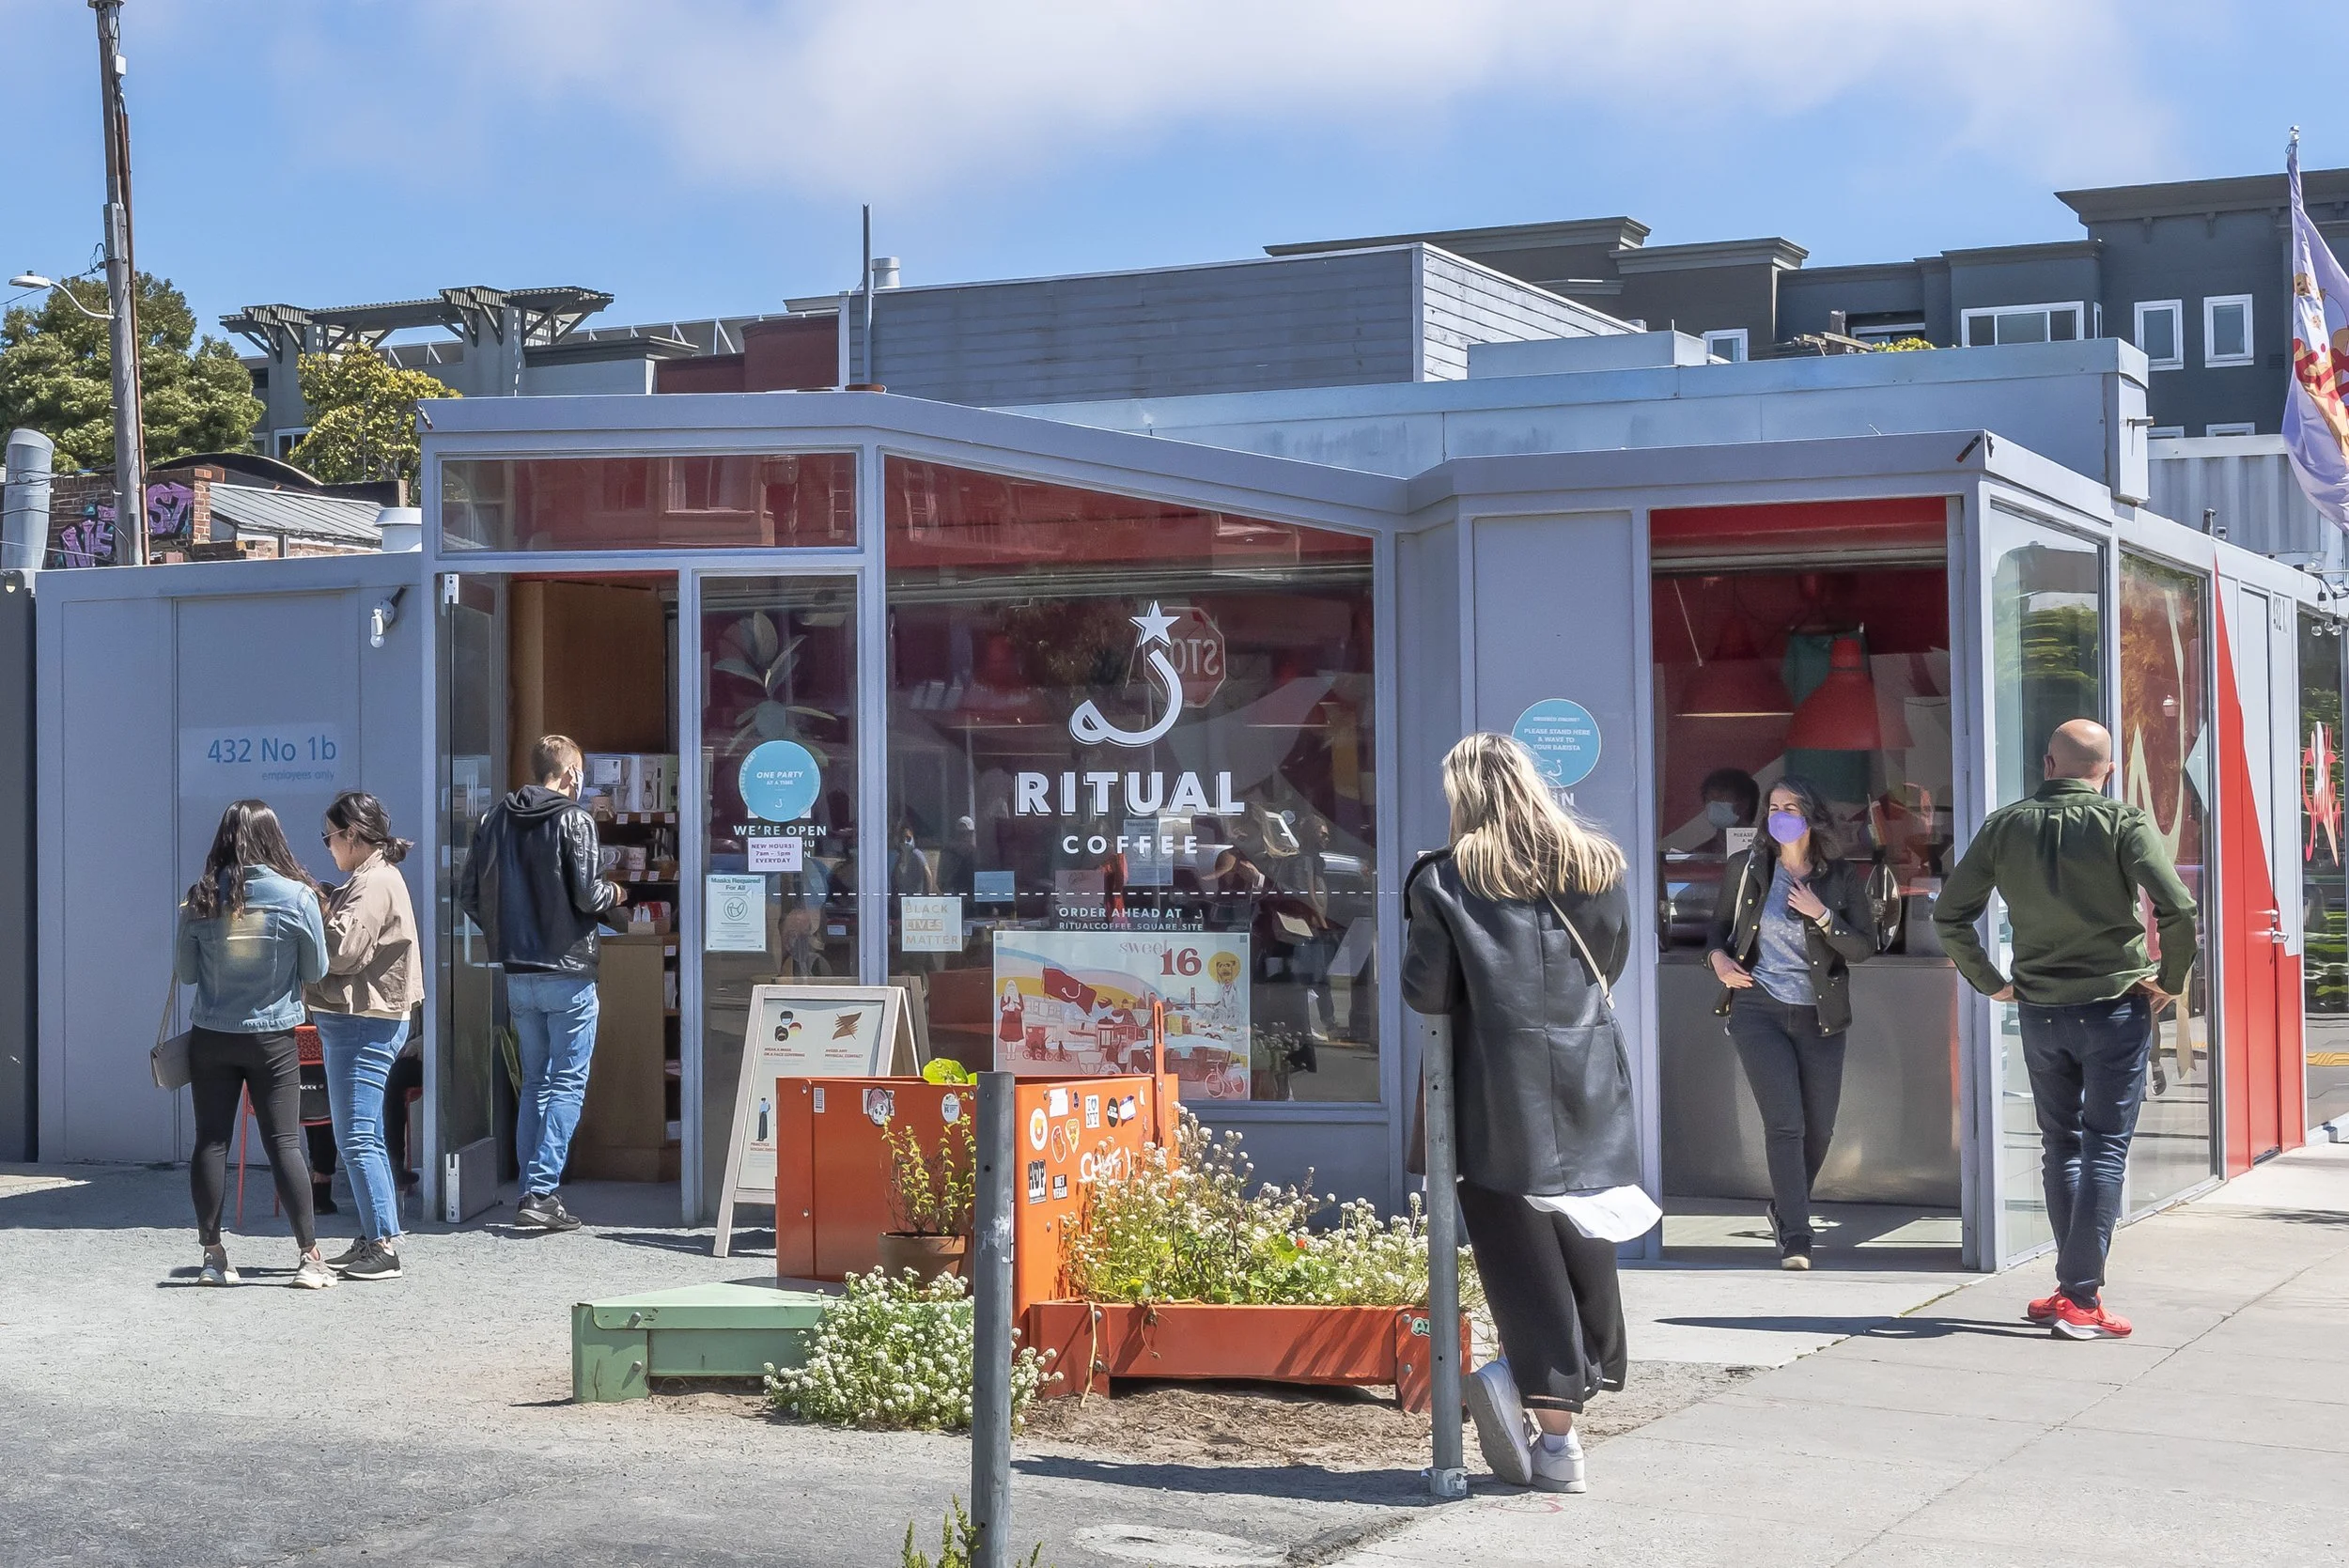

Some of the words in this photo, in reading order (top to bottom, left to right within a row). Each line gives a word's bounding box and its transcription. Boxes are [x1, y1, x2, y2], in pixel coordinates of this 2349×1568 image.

[208, 738, 252, 764] 432
[261, 737, 297, 762] No
[307, 734, 336, 761] 1b
[261, 770, 312, 782] employees
[315, 769, 334, 781] only
[776, 770, 803, 779] PARTY
[1015, 771, 1245, 815] RITUAL
[786, 825, 827, 836] OPEN
[1062, 835, 1198, 855] COFFEE
[905, 904, 948, 914] BLACK
[1059, 908, 1107, 918] ORDER
[1112, 908, 1160, 918] AHEAD
[1164, 908, 1182, 919] AT
[906, 919, 942, 929] LIVES
[1059, 922, 1203, 931] RITUALCOFFEE.SQUARE.SITE
[906, 936, 958, 945] MATTER
[1159, 947, 1203, 976] 16
[1087, 1112, 1098, 1126] NY
